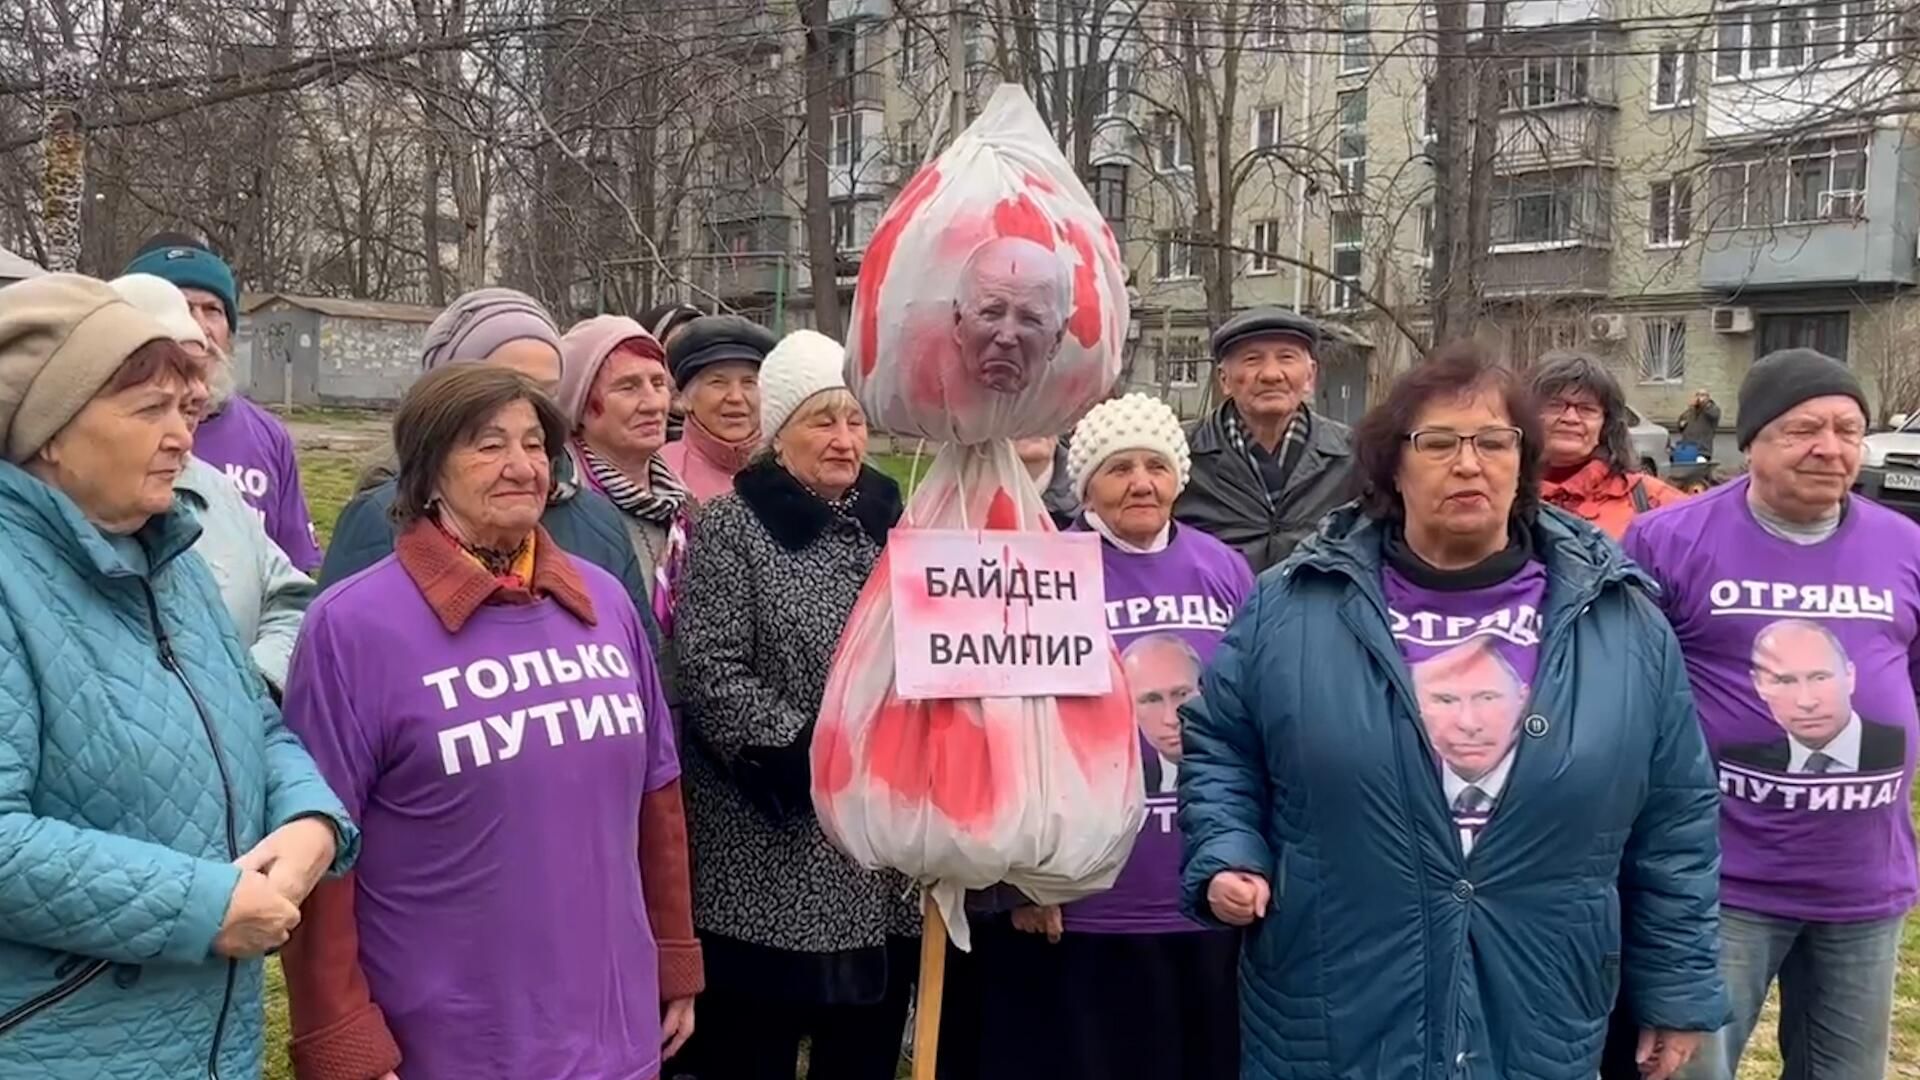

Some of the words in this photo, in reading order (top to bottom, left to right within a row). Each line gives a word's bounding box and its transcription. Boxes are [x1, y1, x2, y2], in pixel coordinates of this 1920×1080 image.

[926, 558, 1077, 606] БАЙДЕН
[1710, 580, 1894, 615] ОТРЯДЫ
[1104, 595, 1233, 627] ТРЯДЫ
[930, 633, 1093, 666] ВАМПИР
[422, 644, 631, 710] ТОЛЬКО
[437, 693, 645, 775] ПУТИН
[1719, 769, 1902, 811] ПУТИНА!
